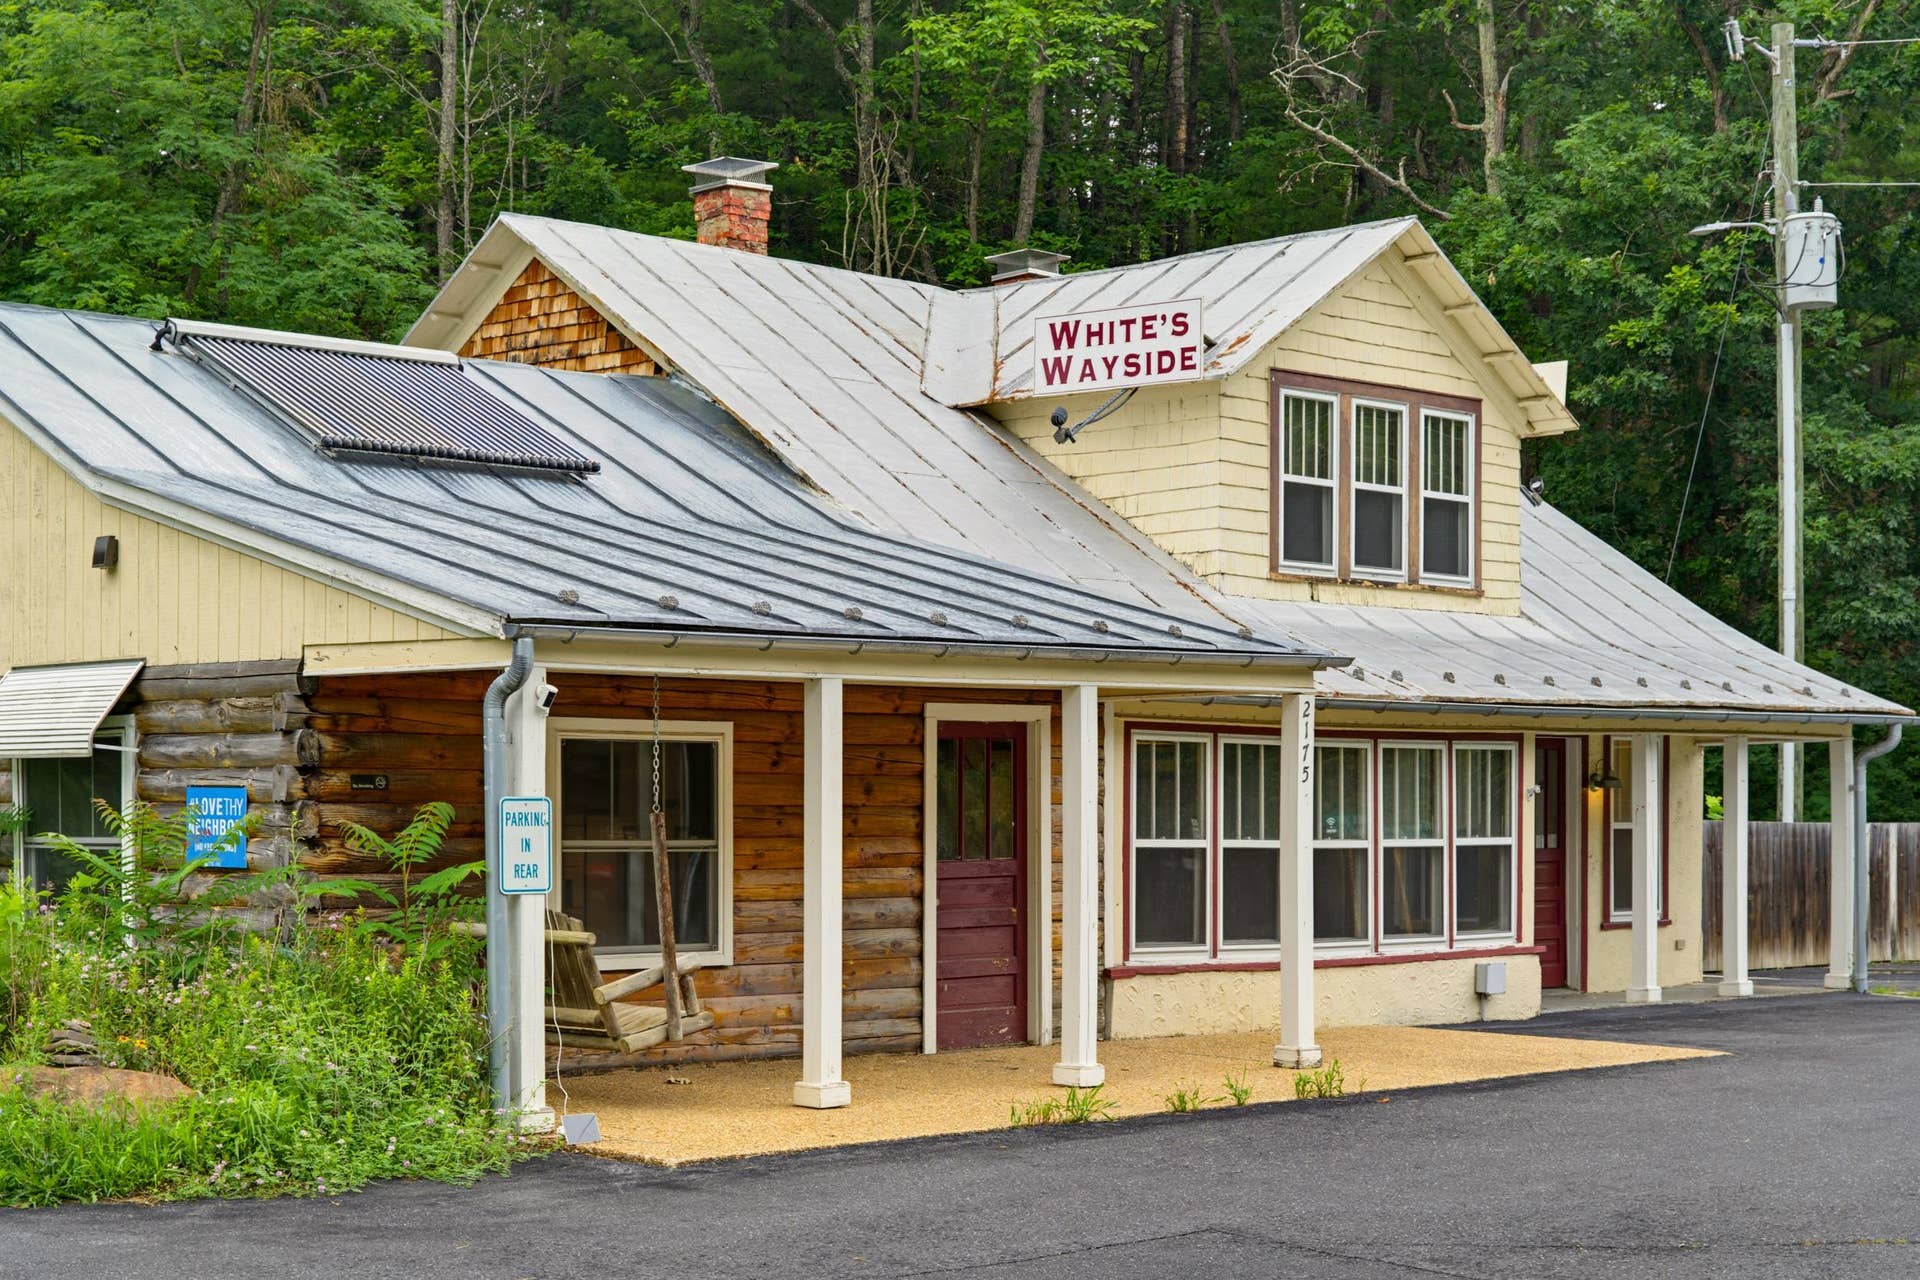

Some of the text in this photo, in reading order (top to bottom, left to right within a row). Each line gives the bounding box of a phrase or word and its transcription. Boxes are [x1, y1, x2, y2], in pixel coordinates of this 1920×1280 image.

[1049, 312, 1190, 351] WHITE'S
[1041, 345, 1198, 386] WAYSIDE
[1302, 701, 1310, 782] 2175
[521, 838, 531, 853] IN
[514, 863, 538, 879] REAR
